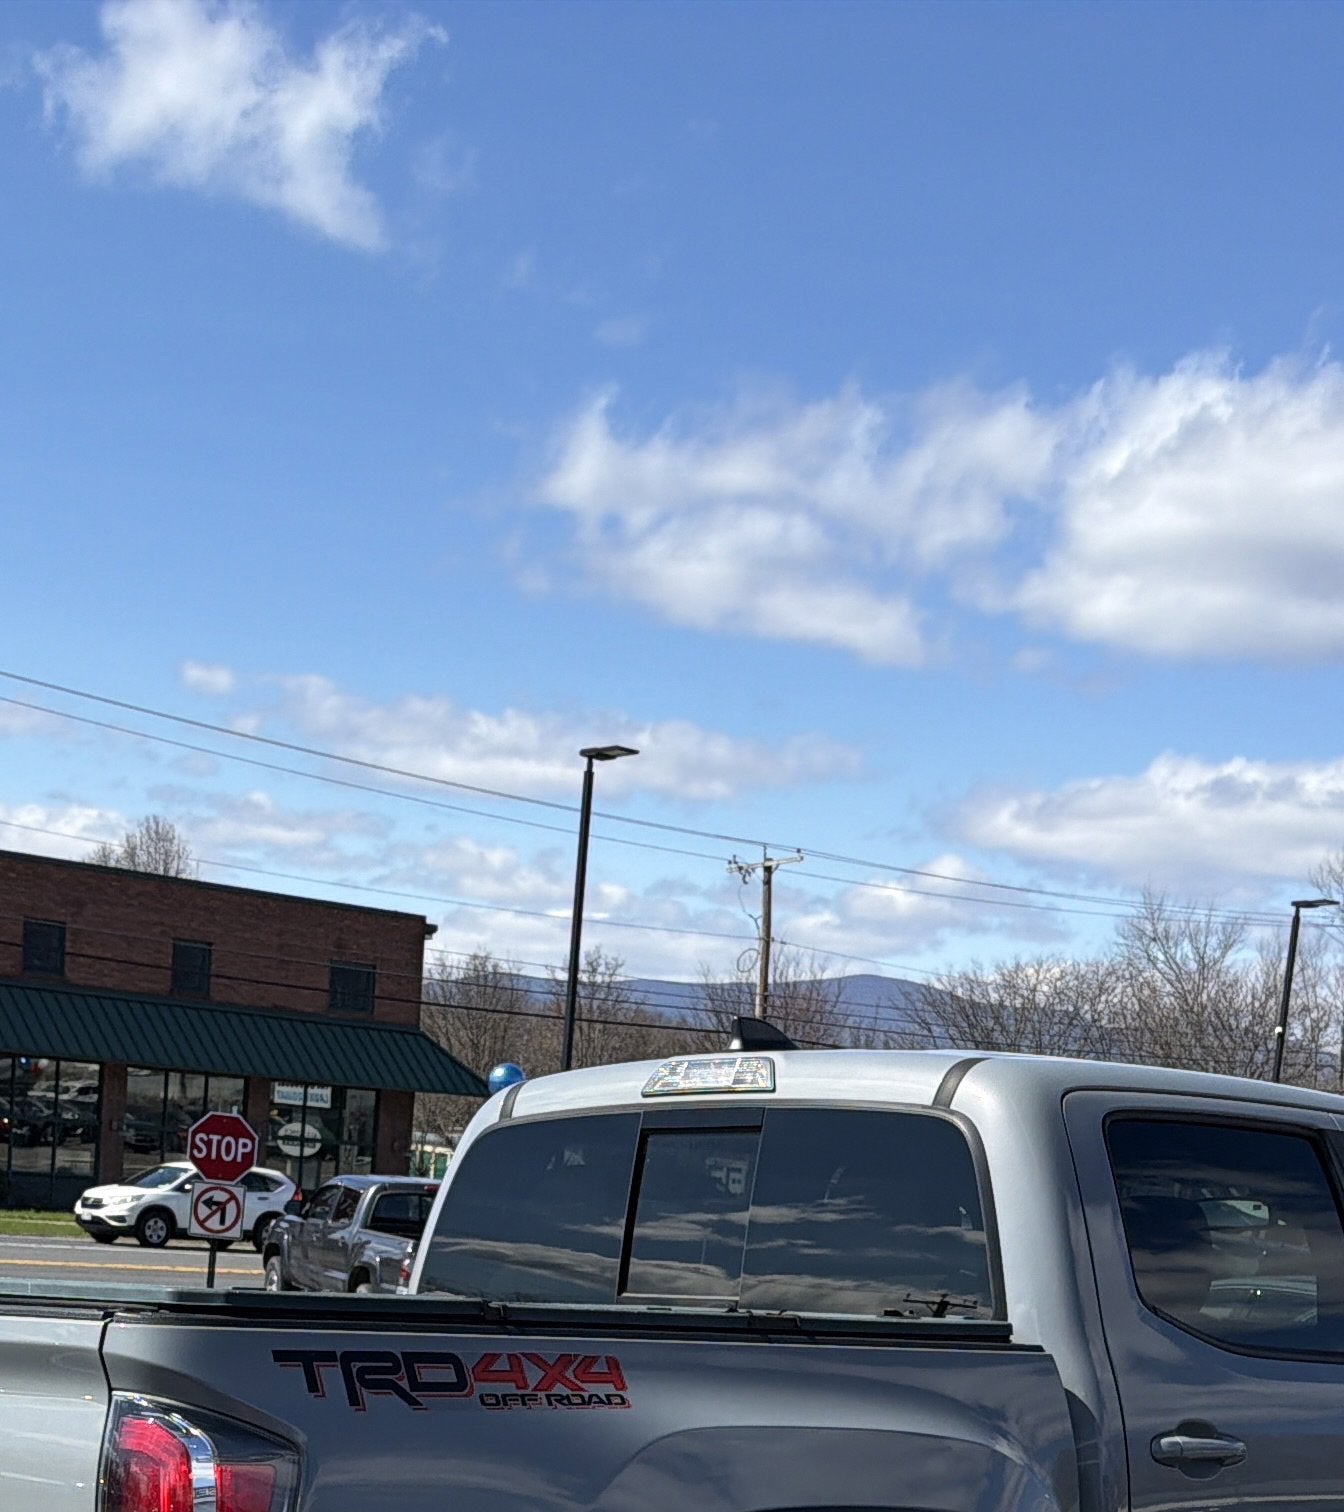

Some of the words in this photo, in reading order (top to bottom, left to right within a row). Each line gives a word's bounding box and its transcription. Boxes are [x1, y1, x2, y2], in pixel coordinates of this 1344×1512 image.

[193, 1133, 253, 1162] STOP
[272, 1350, 474, 1411] TRD
[479, 1393, 542, 1410] OFF
[544, 1393, 632, 1411] ROAD
